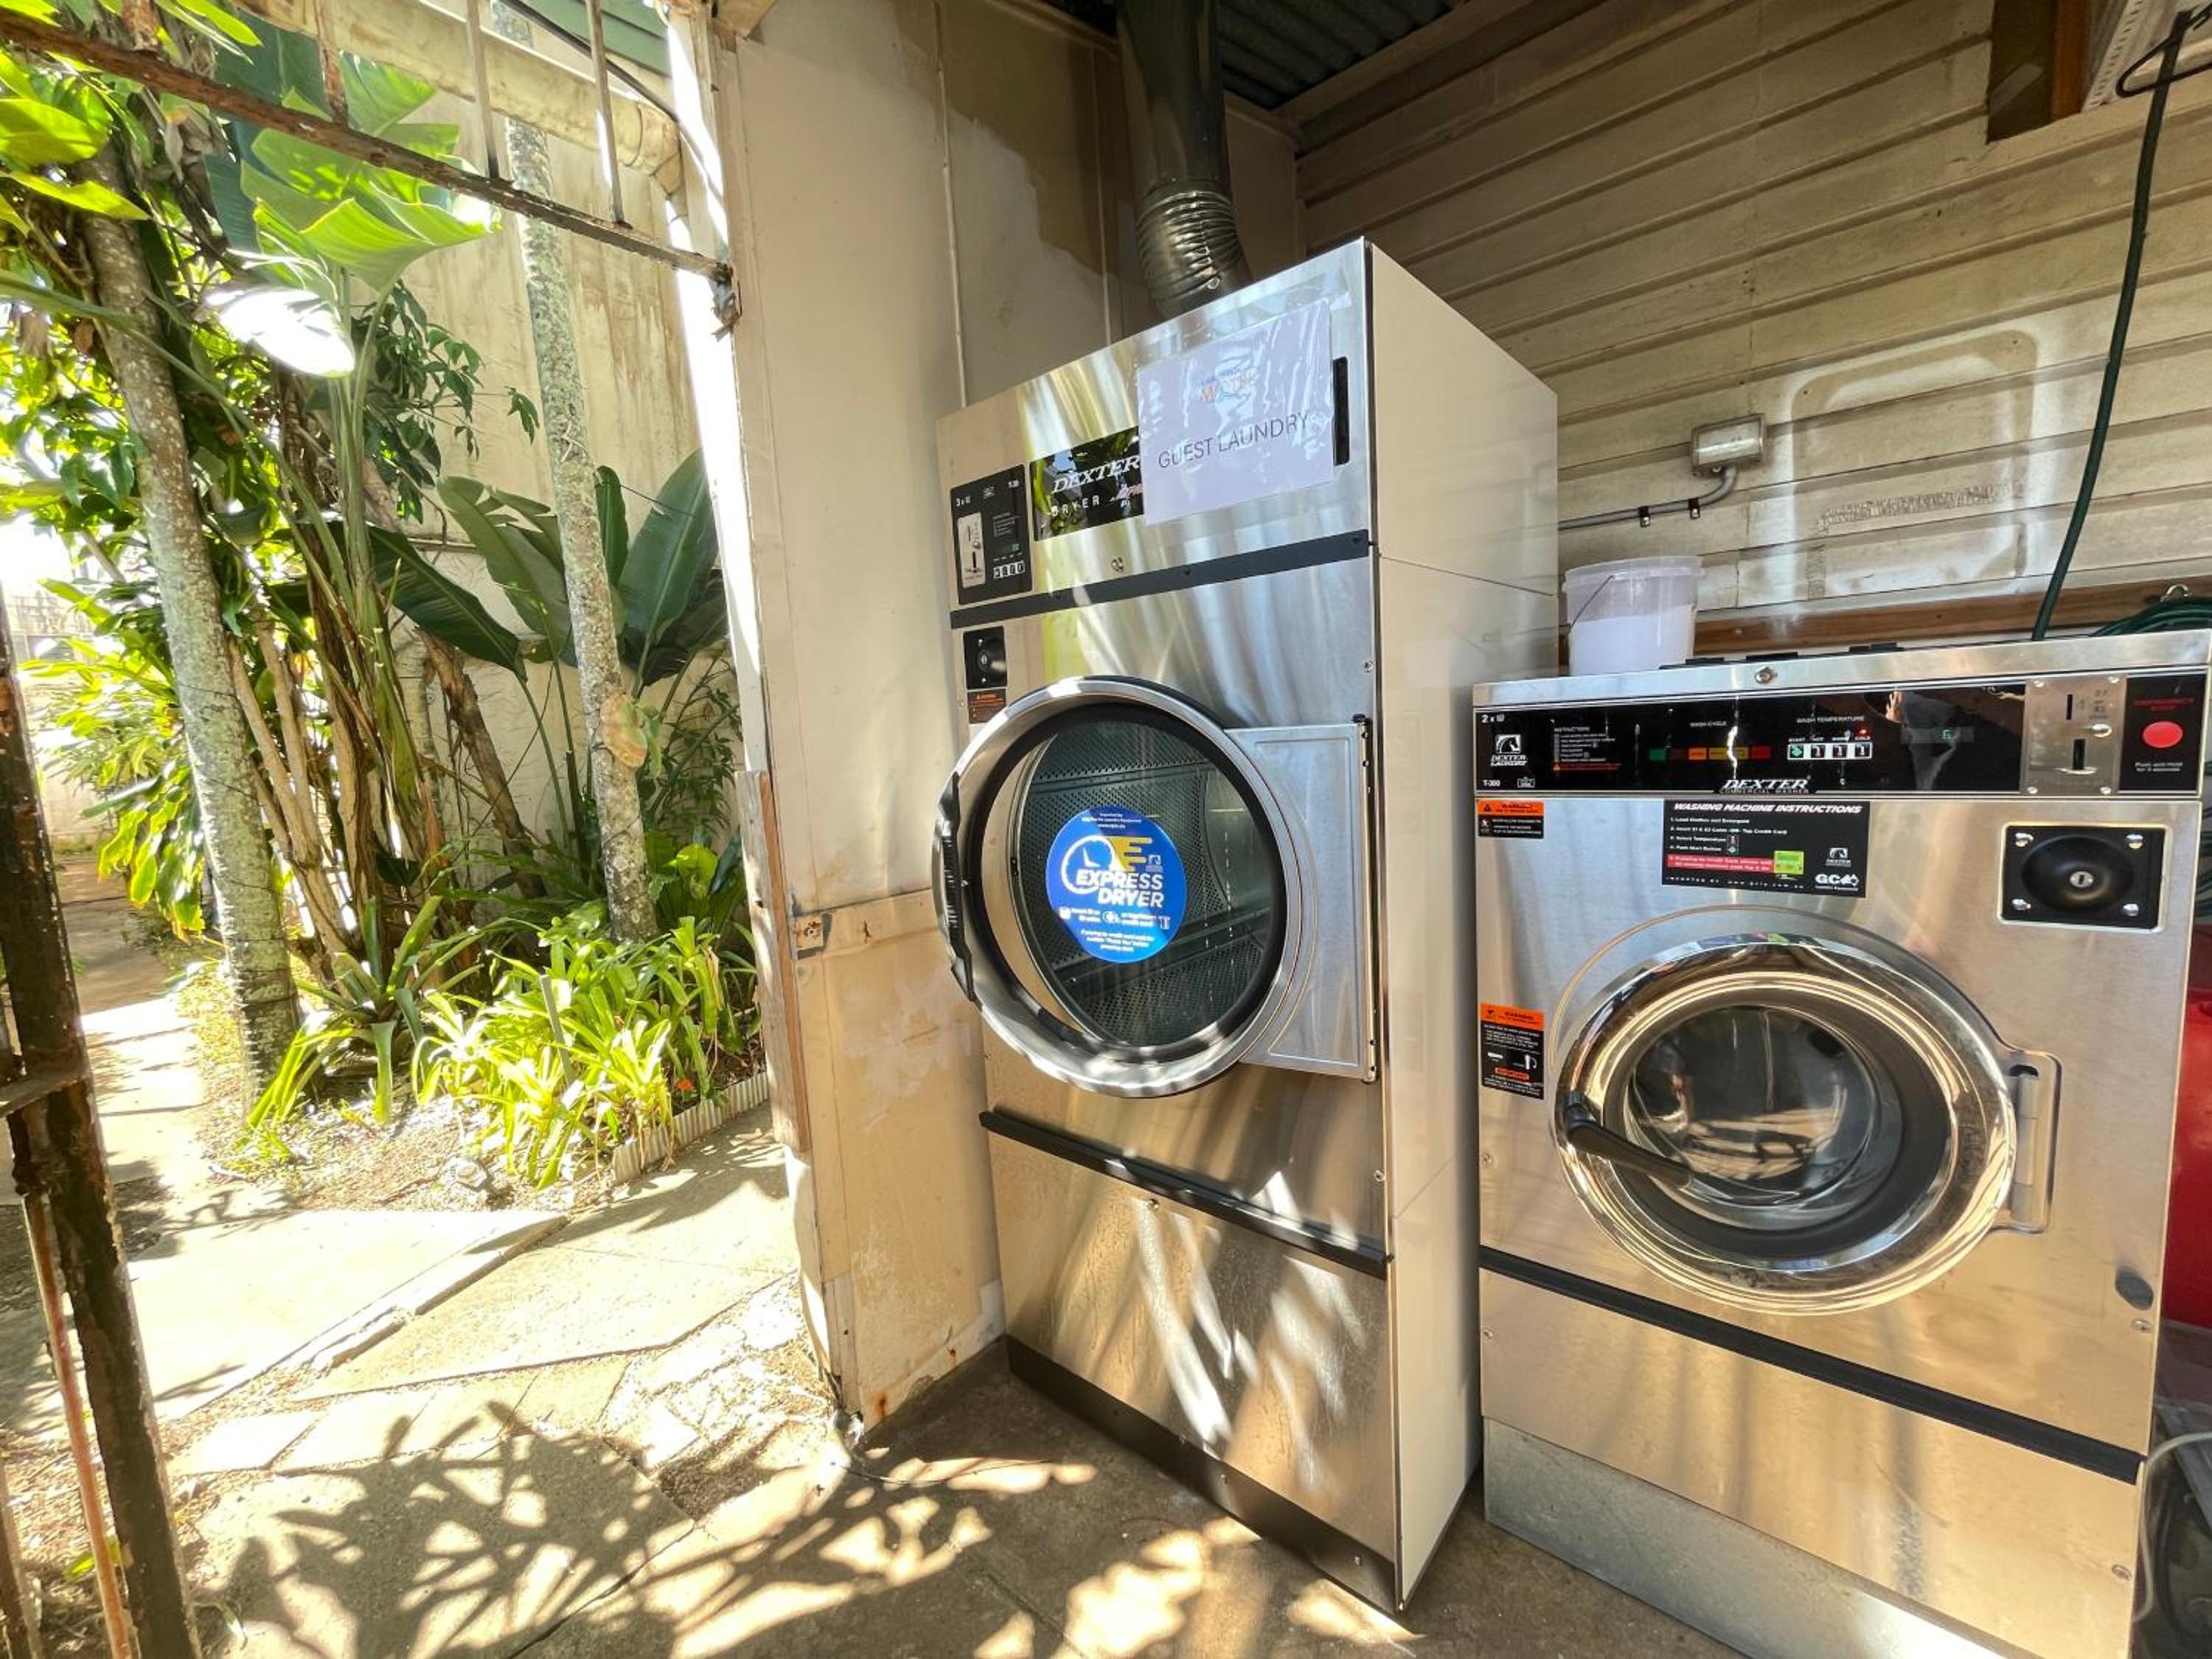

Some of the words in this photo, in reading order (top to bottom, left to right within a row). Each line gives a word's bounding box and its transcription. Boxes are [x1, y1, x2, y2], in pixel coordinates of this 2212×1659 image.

[1158, 437, 1214, 468] GUEST
[1219, 413, 1309, 452] LAUNDRY
[1051, 456, 1140, 494] DEXTER
[1481, 714, 1488, 723] 2
[1722, 779, 1809, 789] DEXTER
[1674, 803, 1724, 811] WASHING
[1723, 804, 1775, 812] MACHINE
[1775, 804, 1863, 813] INSTRUCTIONS
[1076, 869, 1164, 890] EXPRESS
[1097, 888, 1165, 908] DRYER
